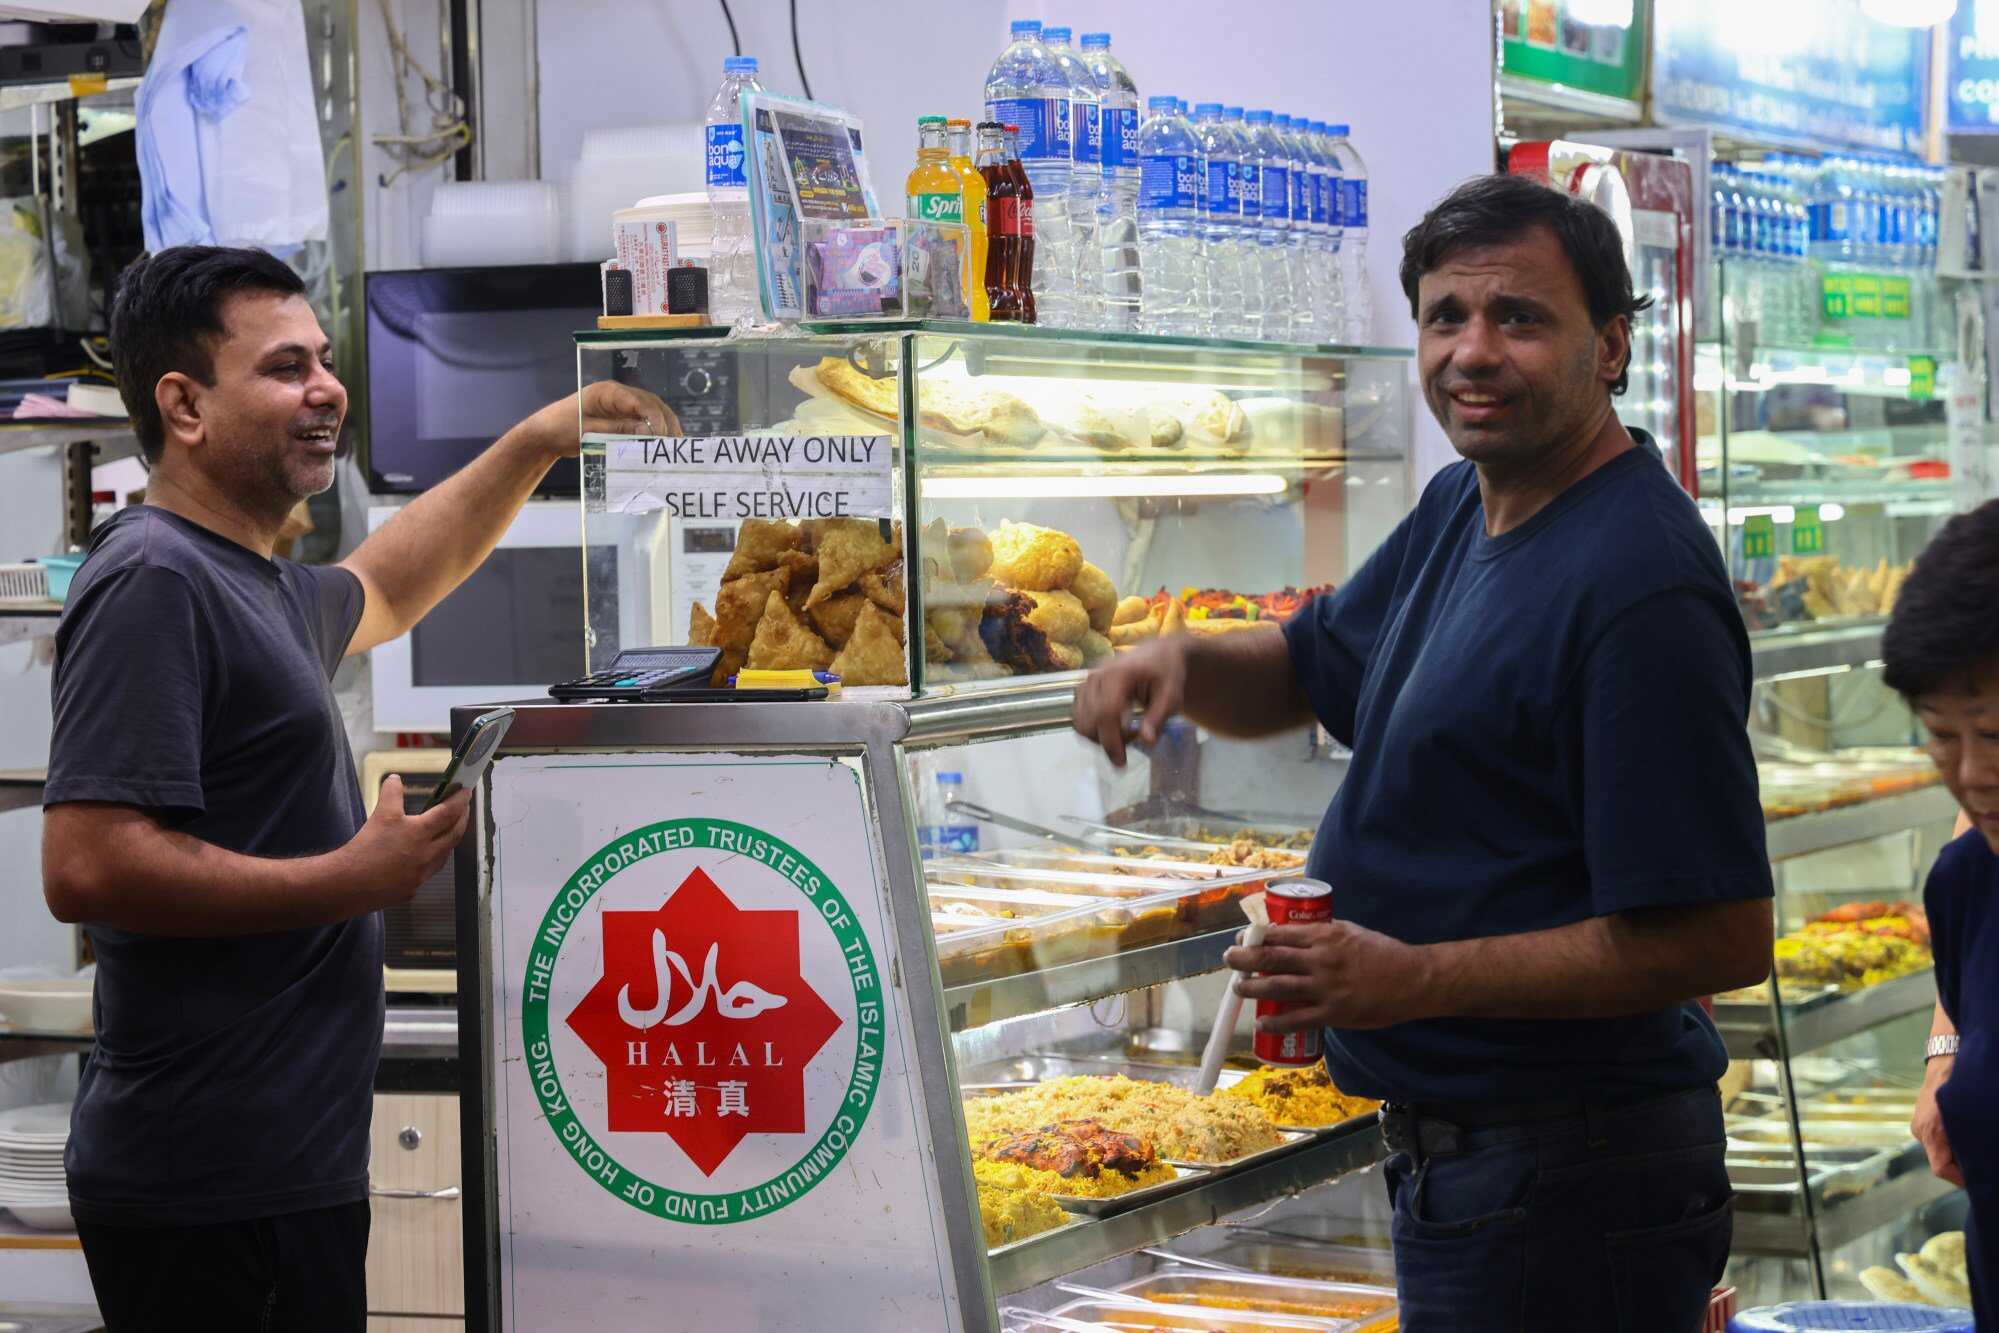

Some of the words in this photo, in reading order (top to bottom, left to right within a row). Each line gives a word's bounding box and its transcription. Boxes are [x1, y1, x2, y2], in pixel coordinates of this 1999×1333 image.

[708, 143, 729, 155] bon
[708, 155, 737, 168] aqua
[926, 196, 961, 217] Spri
[638, 437, 705, 464] TAKE
[713, 437, 795, 463] AWAY
[803, 436, 877, 463] ONLY
[665, 492, 728, 518] SELF
[736, 491, 849, 518] SERVICE
[707, 826, 821, 896] TRUSTEES
[543, 826, 694, 946] INCORPORATED
[822, 898, 851, 930] OF
[529, 952, 554, 1002] THE
[618, 928, 788, 1029] حلال
[844, 937, 873, 991] THE
[625, 1041, 783, 1066] HALAL
[849, 1001, 879, 1108] ISLAMIC
[530, 1033, 567, 1117] KONG.
[663, 1078, 750, 1117] 清真
[562, 1121, 620, 1185] HONG
[740, 1115, 855, 1216] COMMUNITY
[623, 1181, 655, 1206] OF
[664, 1195, 729, 1221] FUND
